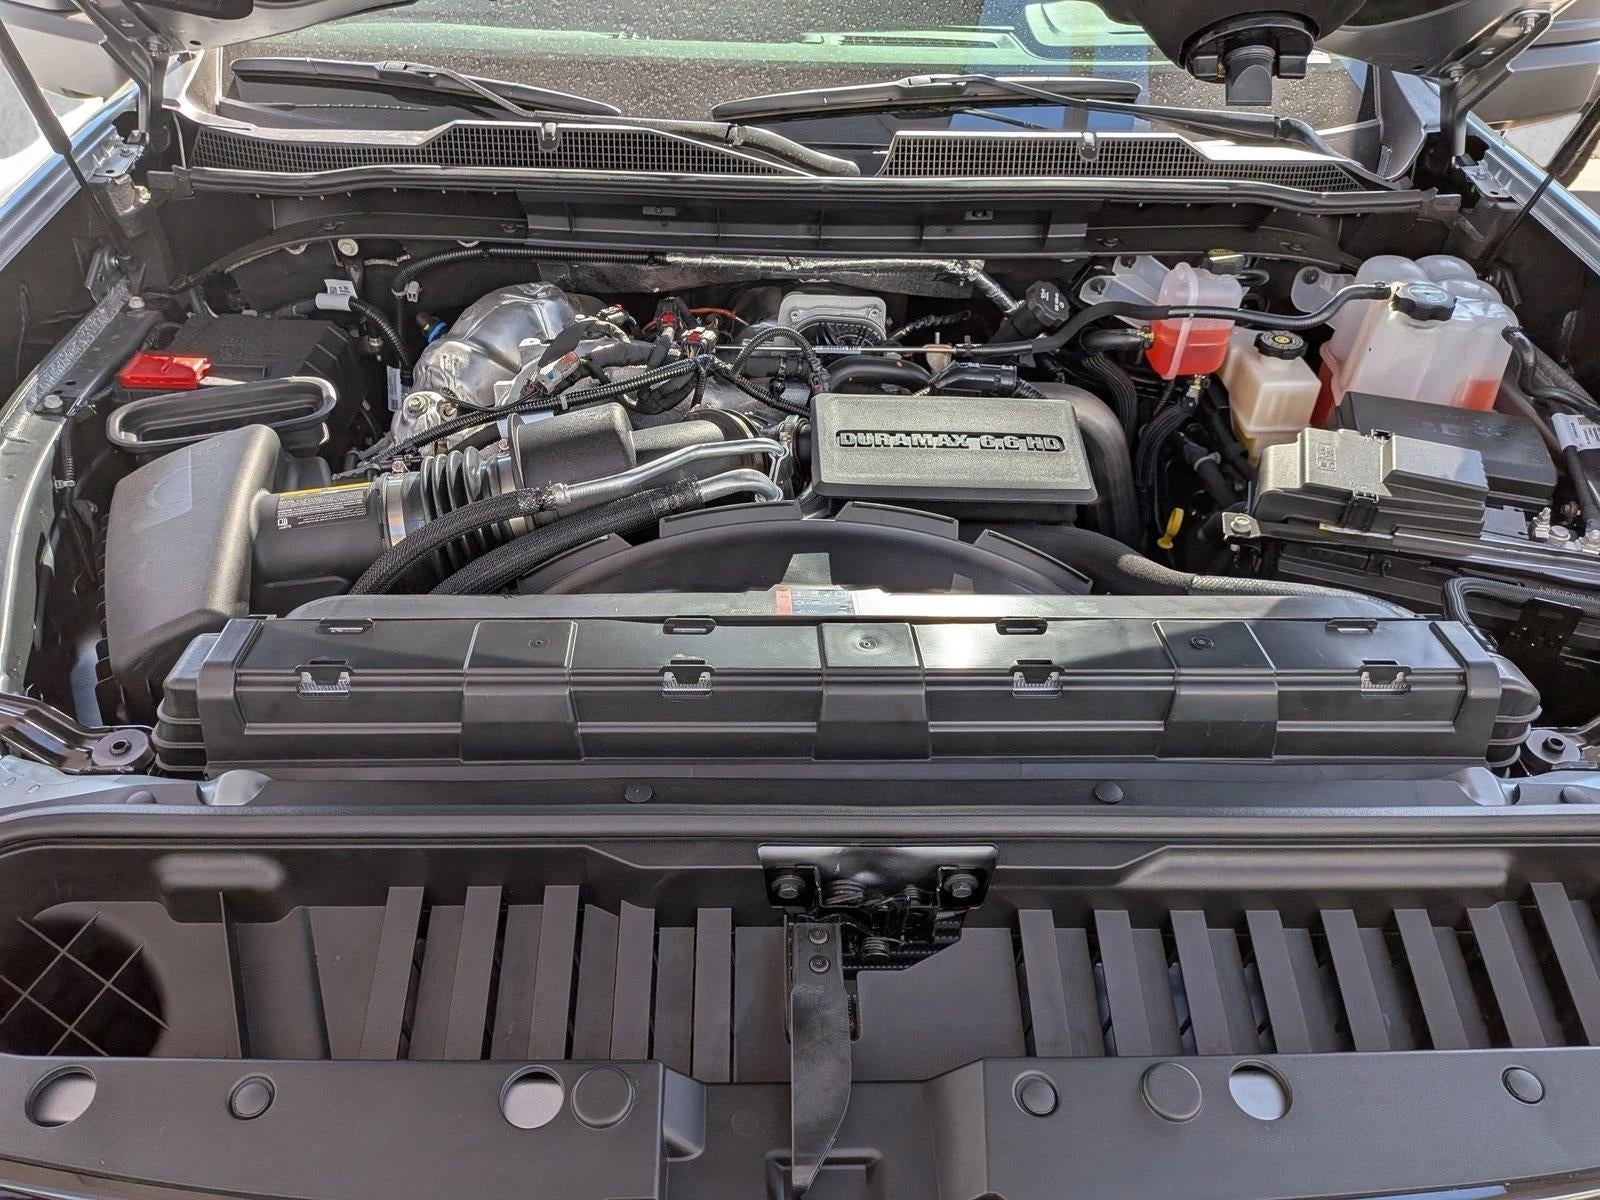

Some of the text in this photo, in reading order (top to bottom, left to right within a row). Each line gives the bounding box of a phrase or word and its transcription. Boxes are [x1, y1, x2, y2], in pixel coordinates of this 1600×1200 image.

[839, 432, 1062, 452] DURAMAX 6.6 HD
